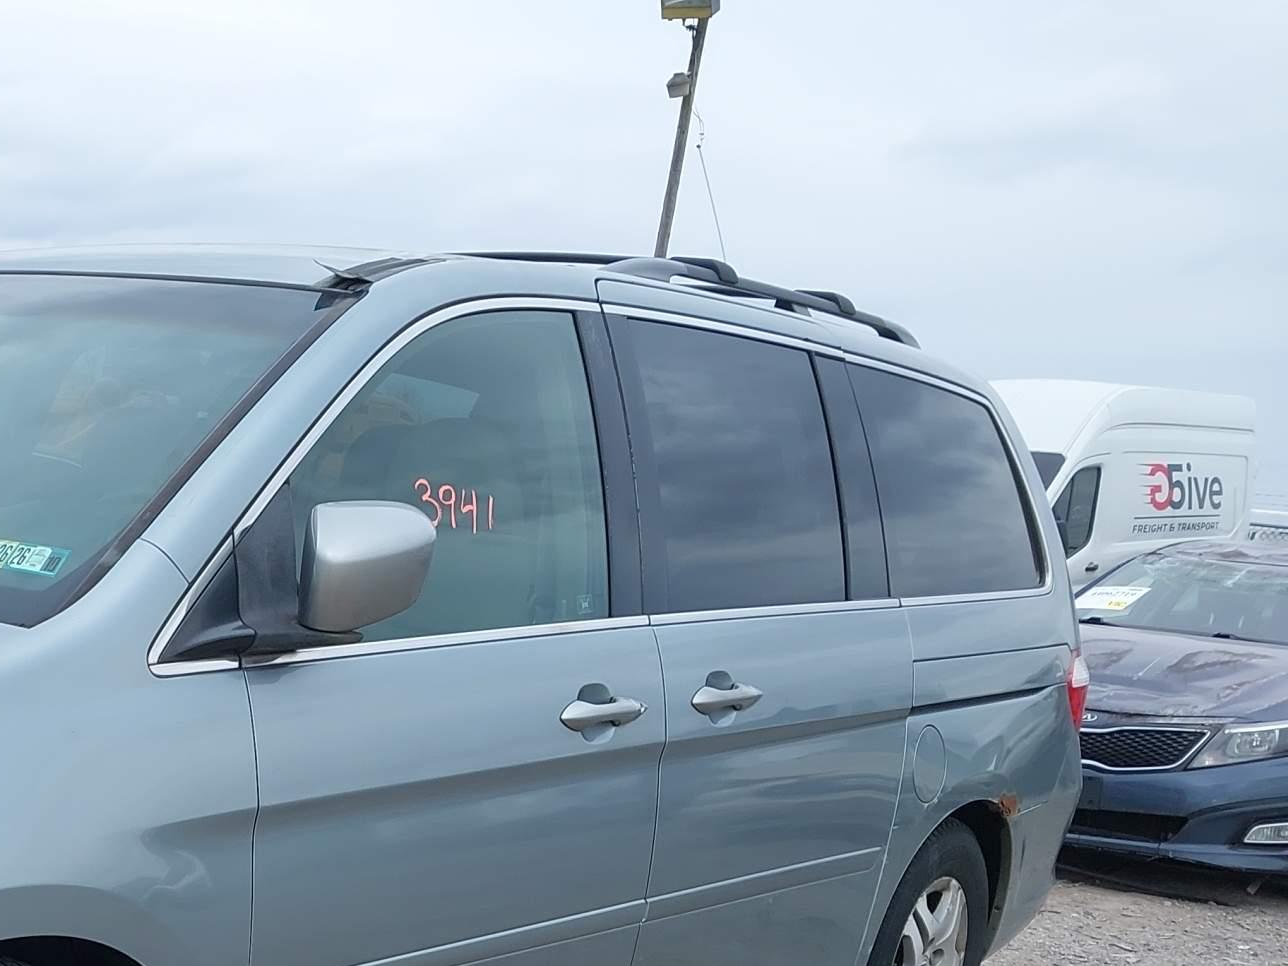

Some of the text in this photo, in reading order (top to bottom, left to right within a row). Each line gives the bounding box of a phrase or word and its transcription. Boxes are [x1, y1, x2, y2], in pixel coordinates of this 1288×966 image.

[414, 478, 494, 535] 3941
[1132, 523, 1168, 534] FREIGHT
[1177, 521, 1219, 532] TRANSPORT
[10, 547, 31, 565] 26
